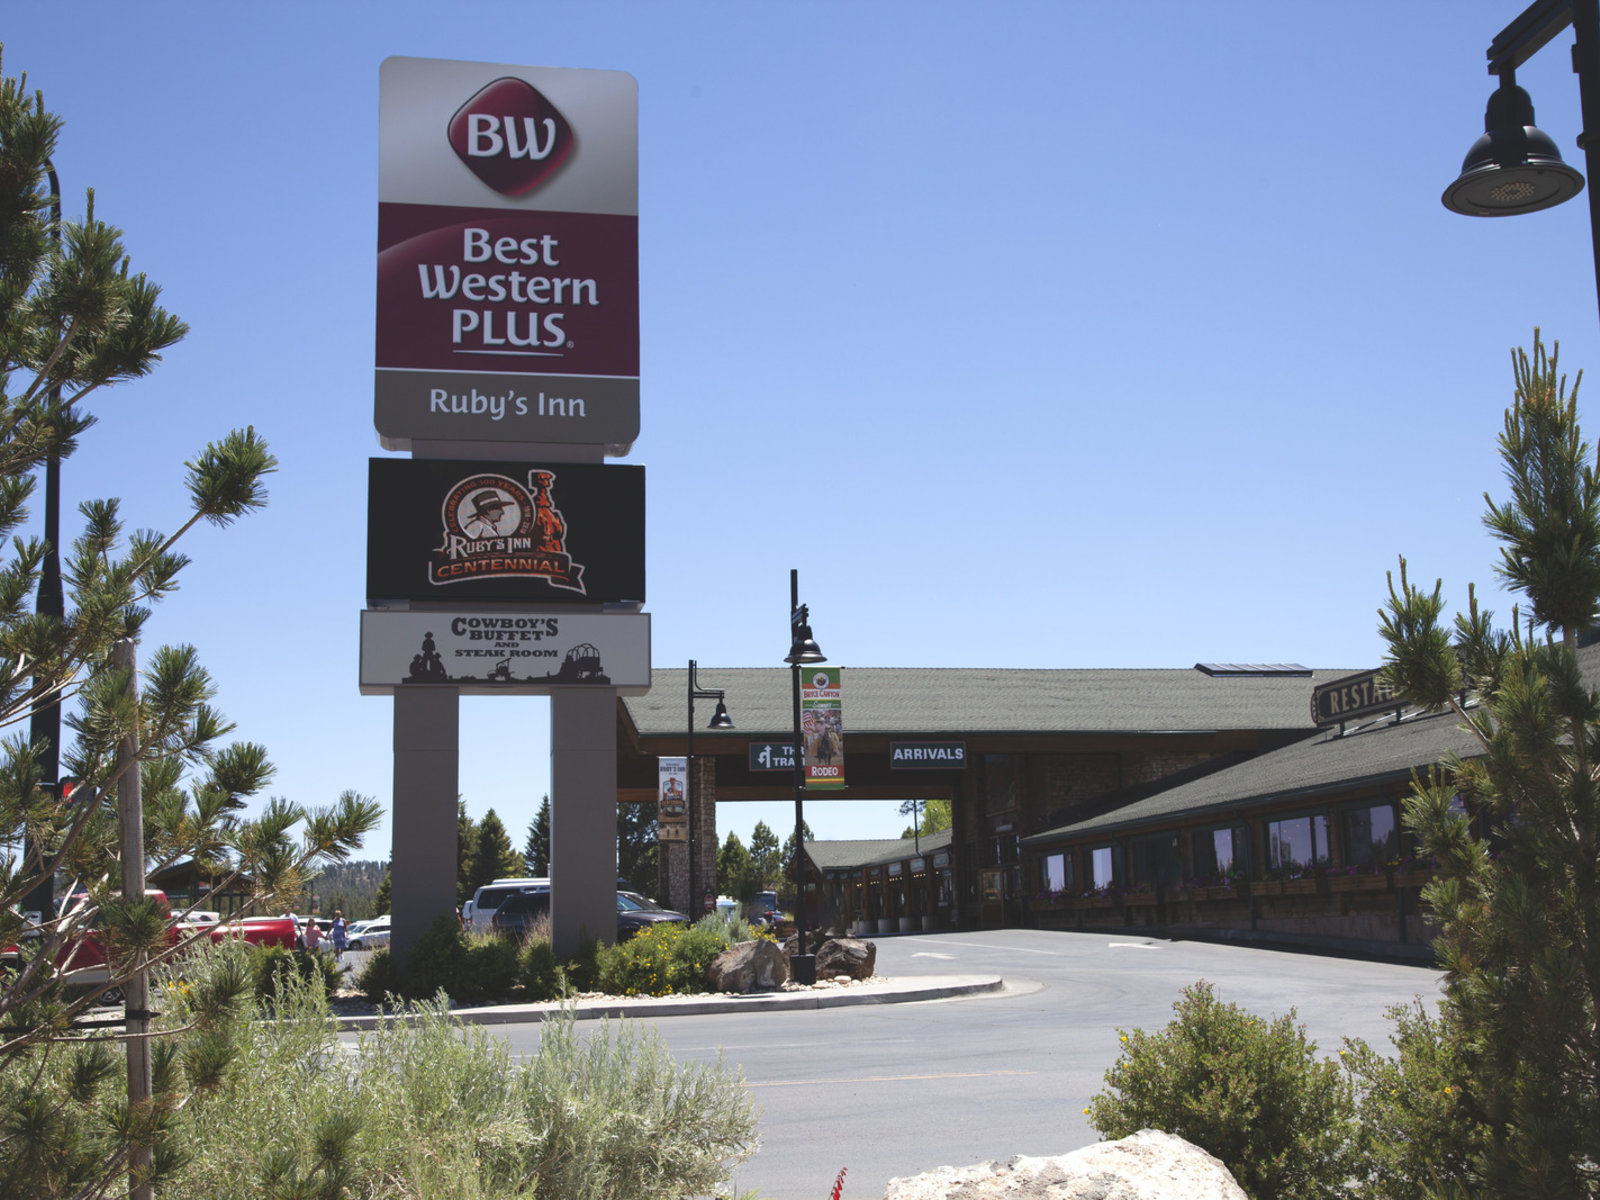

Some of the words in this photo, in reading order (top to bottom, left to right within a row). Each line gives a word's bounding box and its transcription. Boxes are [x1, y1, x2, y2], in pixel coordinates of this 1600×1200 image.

[466, 113, 557, 161] BW
[463, 227, 560, 267] Best
[417, 263, 600, 306] Western
[451, 308, 567, 349] PLUS
[430, 388, 529, 421] Ruby's
[538, 391, 587, 417] Inn
[498, 480, 526, 501] YEARS
[447, 533, 505, 560] RUBY'S
[507, 537, 532, 554] INN
[437, 558, 566, 578] CENTENNIAL
[451, 617, 559, 637] COWBOY'S
[469, 630, 544, 641] BUFFET
[454, 649, 506, 658] STEAK
[509, 649, 559, 658] ROOM
[819, 689, 841, 698] CANYON
[893, 748, 965, 760] ARRIVALS
[811, 766, 839, 777] RODEO
